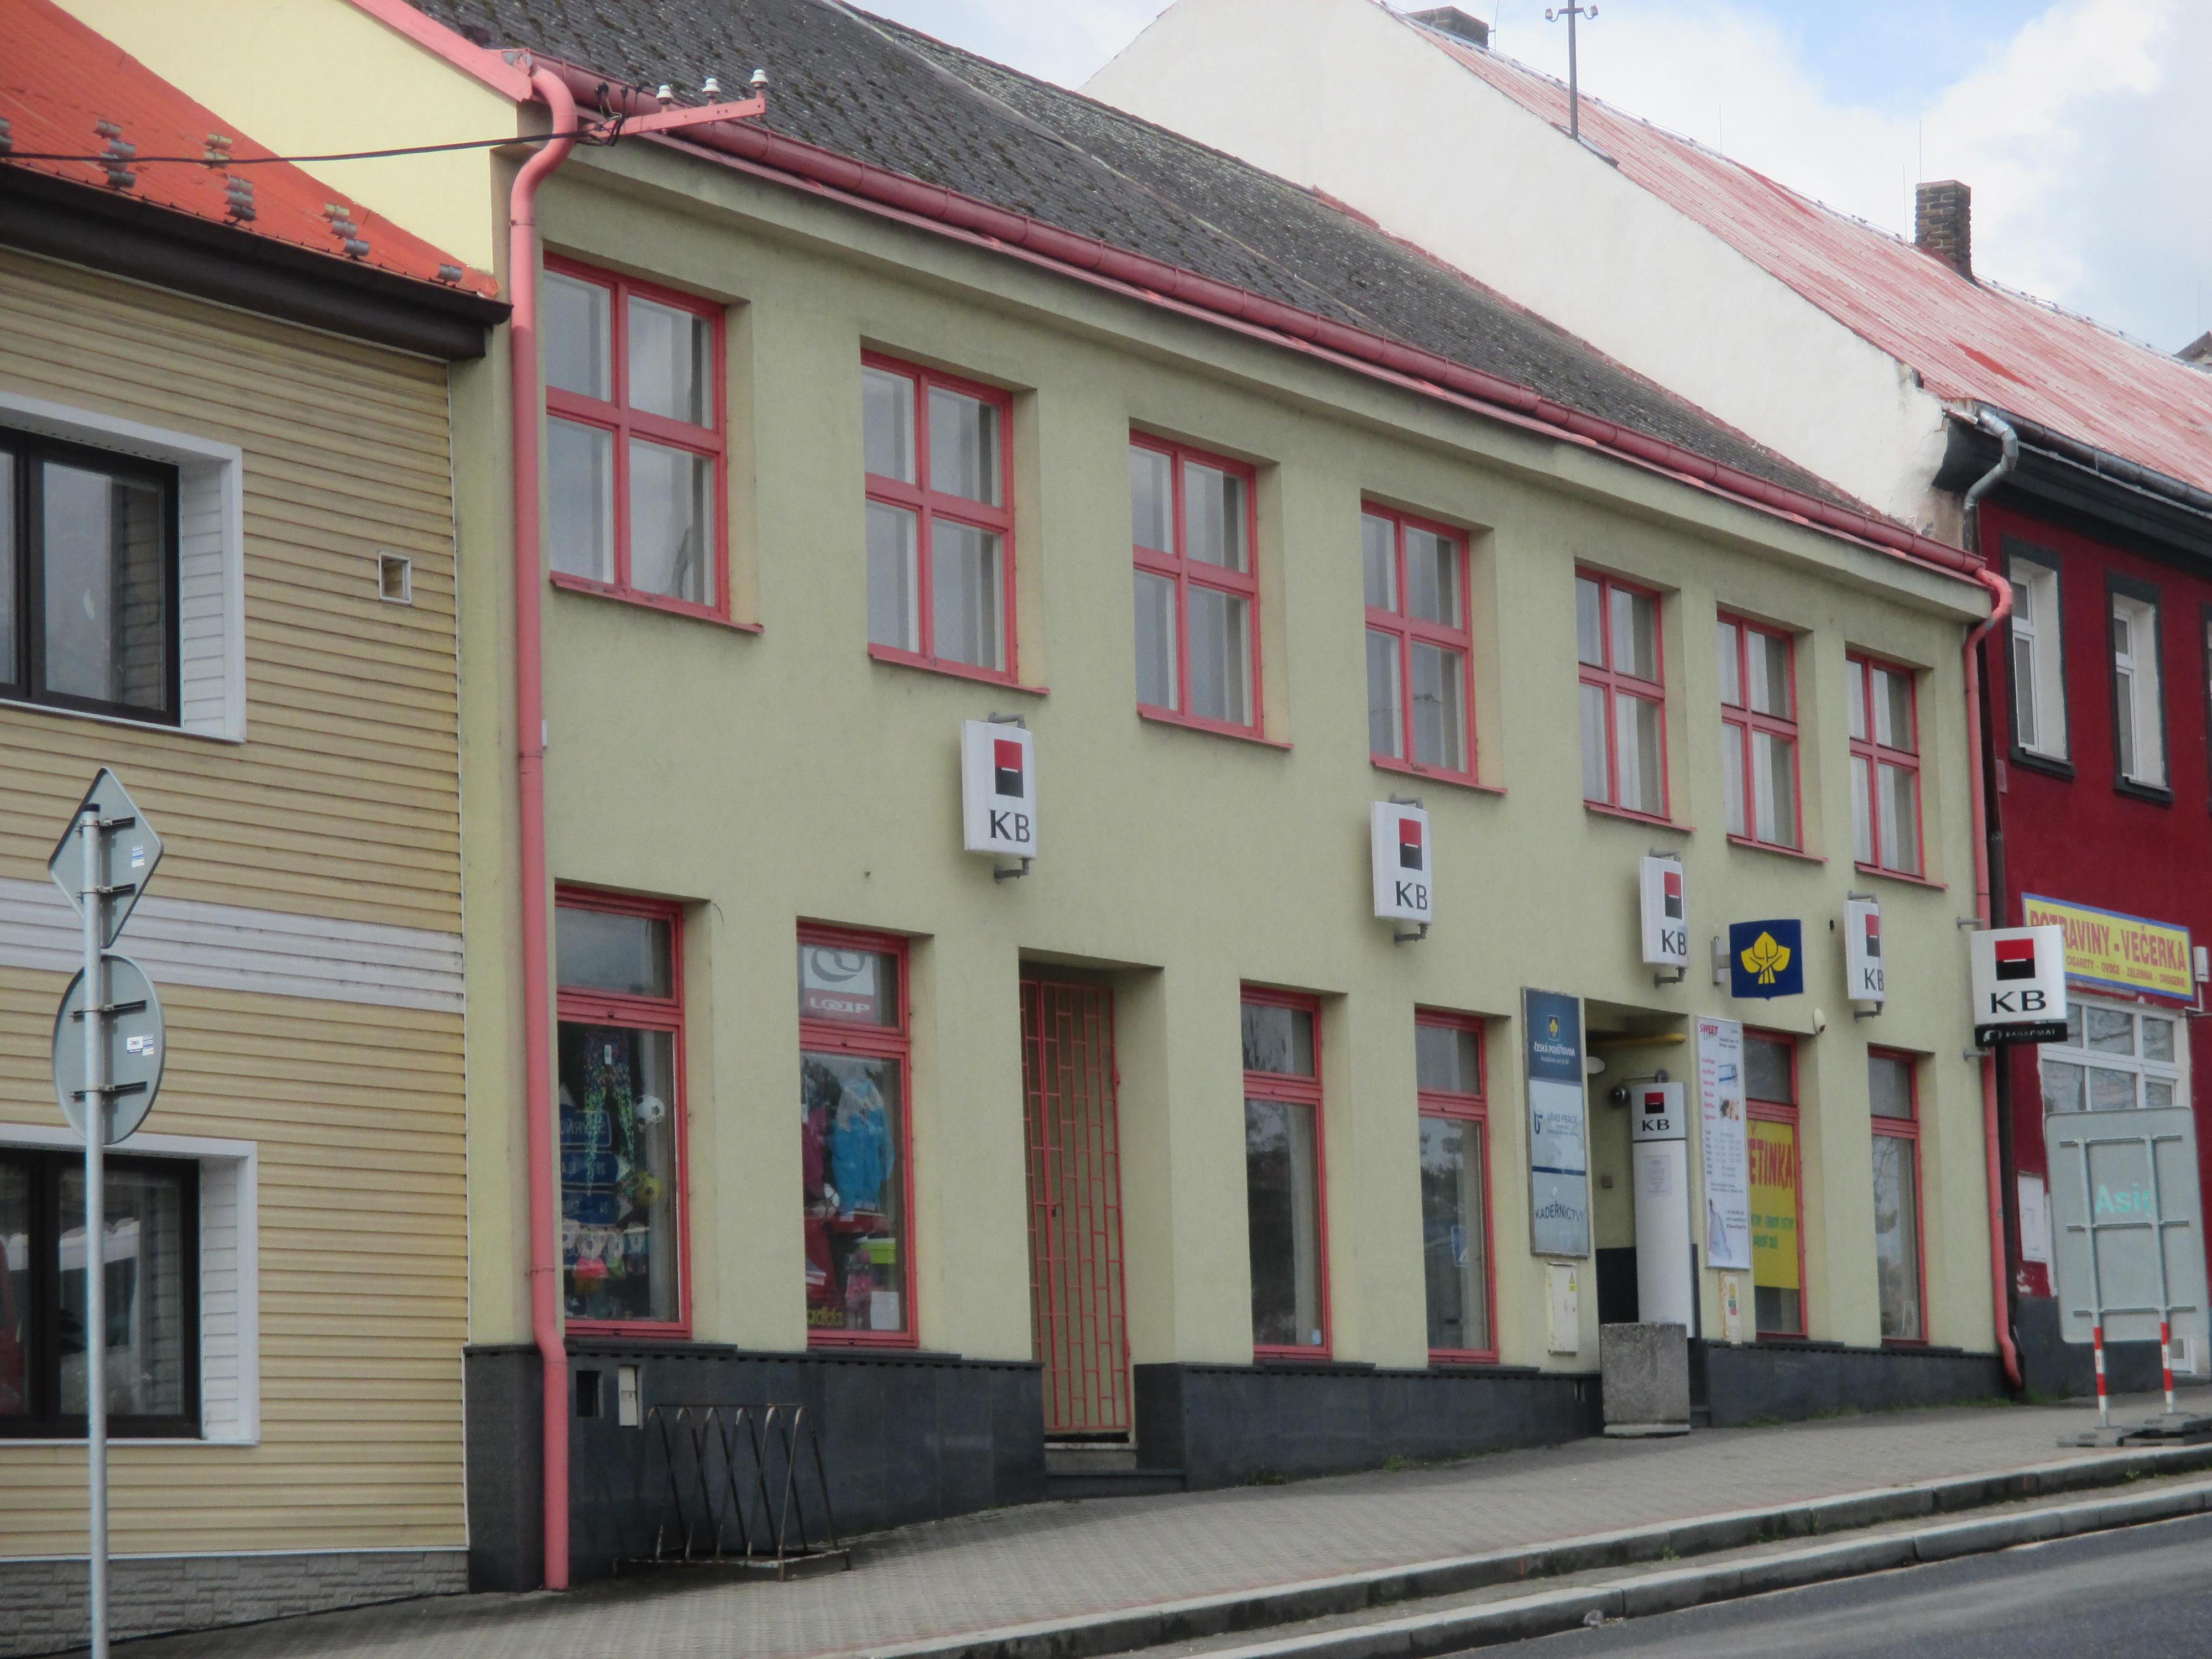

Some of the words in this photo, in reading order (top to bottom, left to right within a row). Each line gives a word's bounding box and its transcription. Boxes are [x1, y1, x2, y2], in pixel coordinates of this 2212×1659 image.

[988, 809, 1030, 843] KB
[1395, 880, 1428, 910] KB
[1661, 928, 1687, 956] KB
[2120, 924, 2188, 972] VEČERKA
[1864, 968, 1885, 992] KB
[1990, 989, 2047, 1014] KB
[1533, 1041, 1548, 1053] ČESKÁ
[1641, 1119, 1670, 1131] KB
